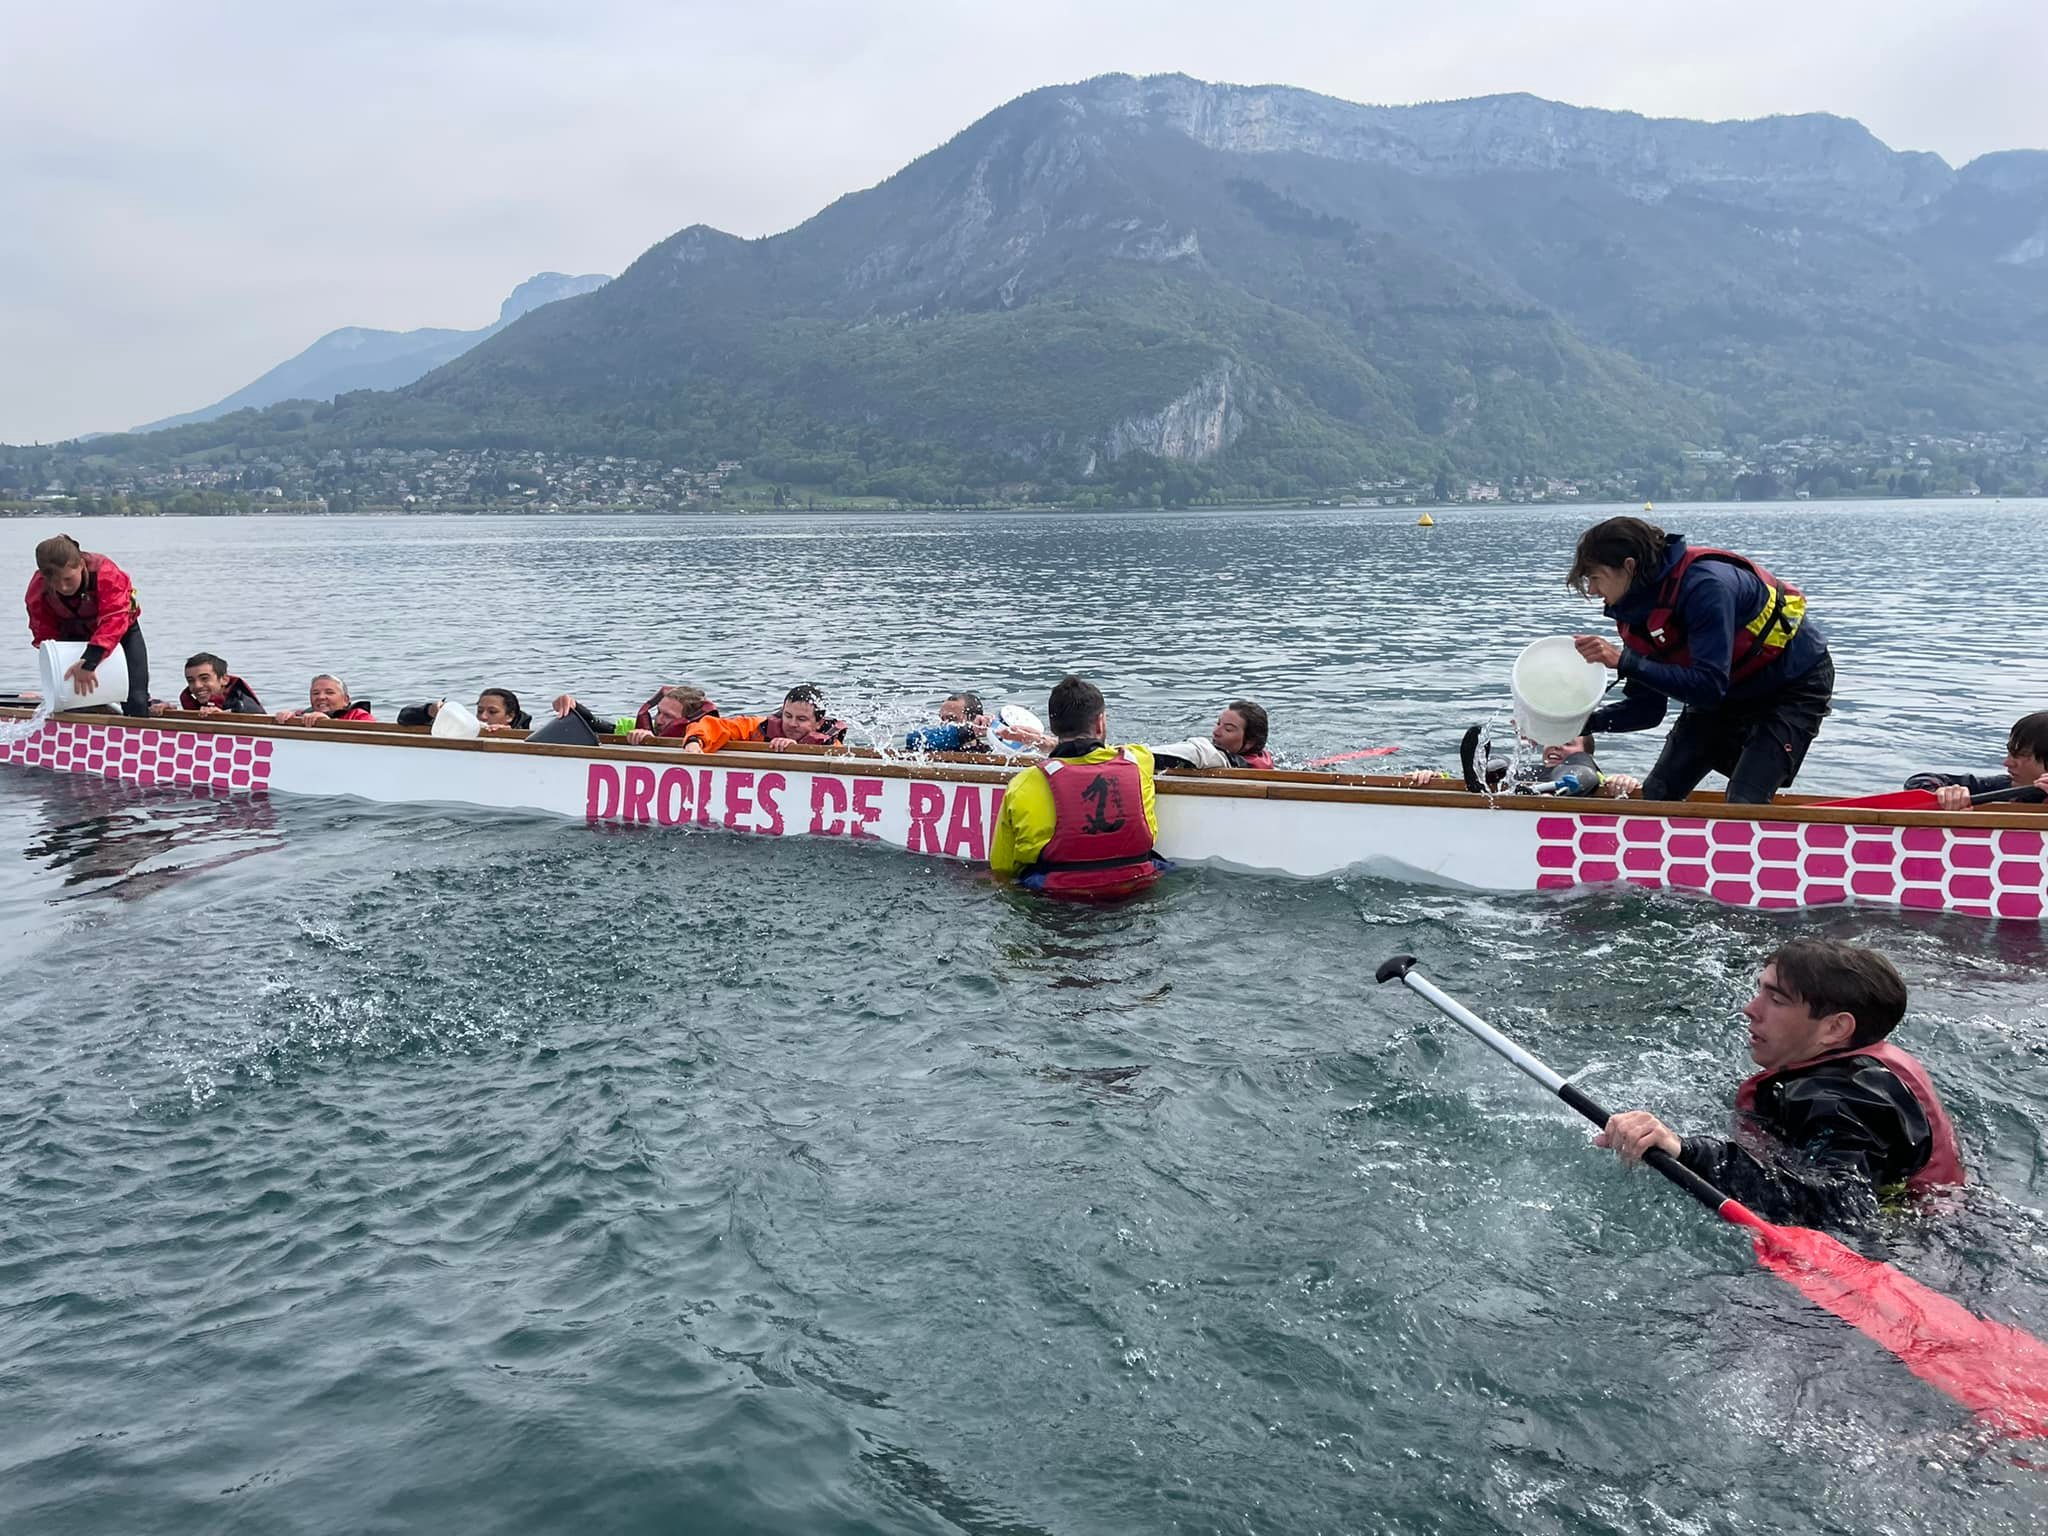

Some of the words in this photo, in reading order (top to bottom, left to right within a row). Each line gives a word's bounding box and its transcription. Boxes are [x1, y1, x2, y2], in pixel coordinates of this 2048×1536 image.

[586, 764, 786, 836] DROLES
[809, 776, 884, 839] DE
[906, 782, 1007, 860] RA
